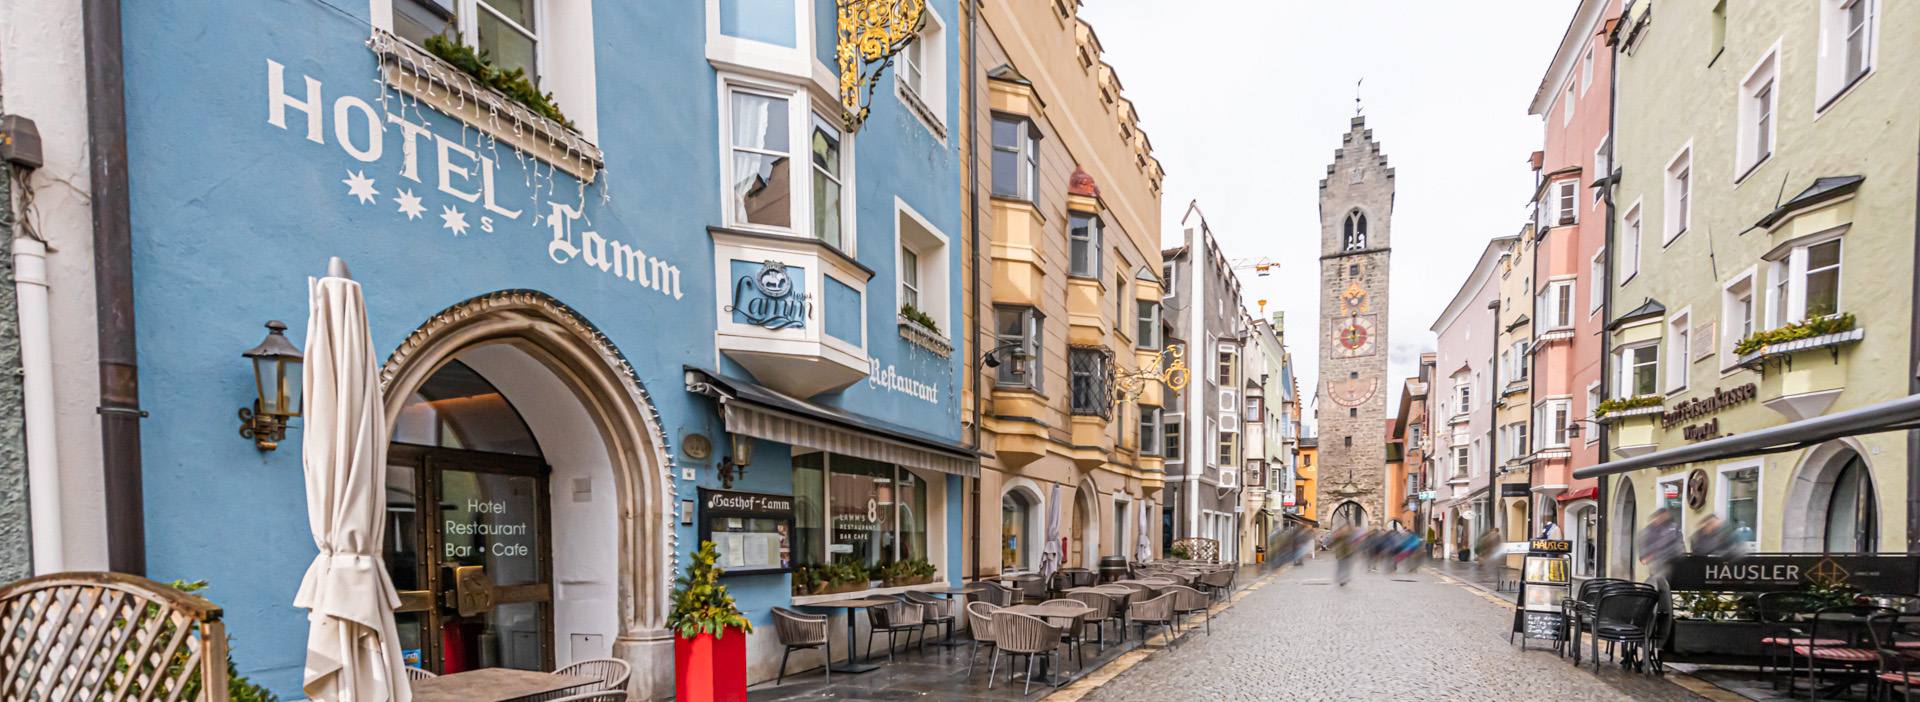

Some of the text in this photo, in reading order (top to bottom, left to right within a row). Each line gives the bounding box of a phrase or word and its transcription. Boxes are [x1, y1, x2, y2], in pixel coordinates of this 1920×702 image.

[266, 58, 523, 219] HOTEL
[547, 200, 684, 300] Lamm
[724, 275, 815, 329] Lamm
[467, 499, 506, 514] Hotel
[867, 498, 877, 523] 8
[445, 520, 526, 535] Restaurant
[445, 543, 528, 557] Bar Cafe
